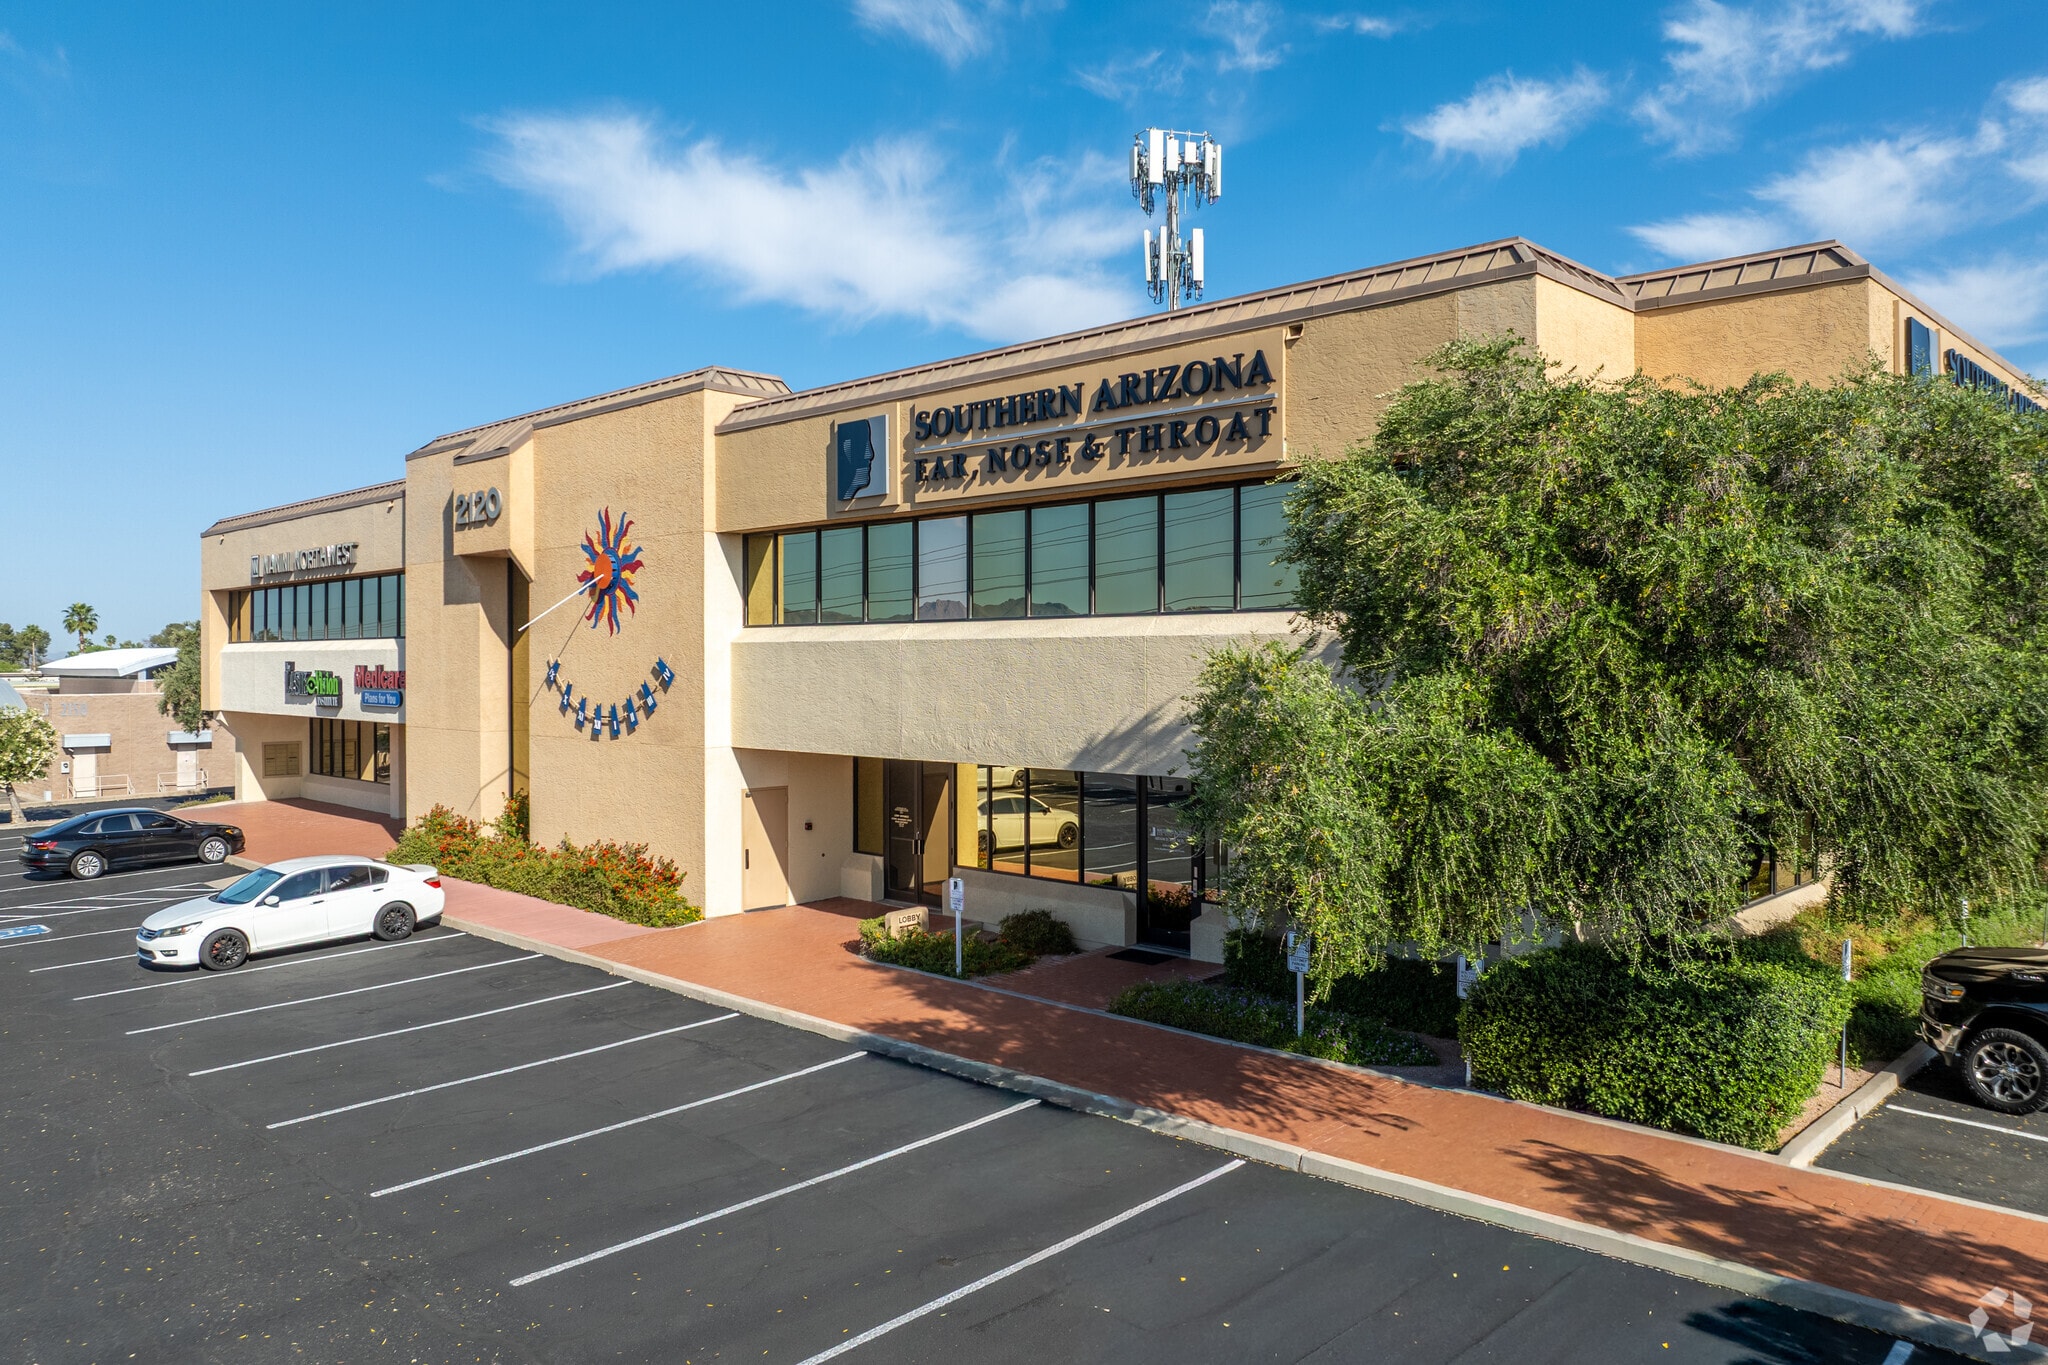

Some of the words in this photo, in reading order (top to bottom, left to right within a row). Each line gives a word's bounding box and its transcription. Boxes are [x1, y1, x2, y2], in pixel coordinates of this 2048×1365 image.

[915, 382, 1085, 440] SOUTHERN
[1093, 349, 1276, 412] ARIZONA
[914, 453, 979, 483] EAR,
[986, 437, 1071, 474] NOSE
[1081, 433, 1105, 460] &
[1114, 406, 1277, 455] THROAT
[456, 486, 502, 524] 2120
[294, 542, 357, 570] NORTHWEST
[354, 665, 406, 689] Medicare
[662, 668, 671, 681] IV
[364, 692, 378, 704] Plans
[378, 692, 386, 704] for
[386, 693, 397, 705] You
[898, 913, 921, 924] LOBBY
